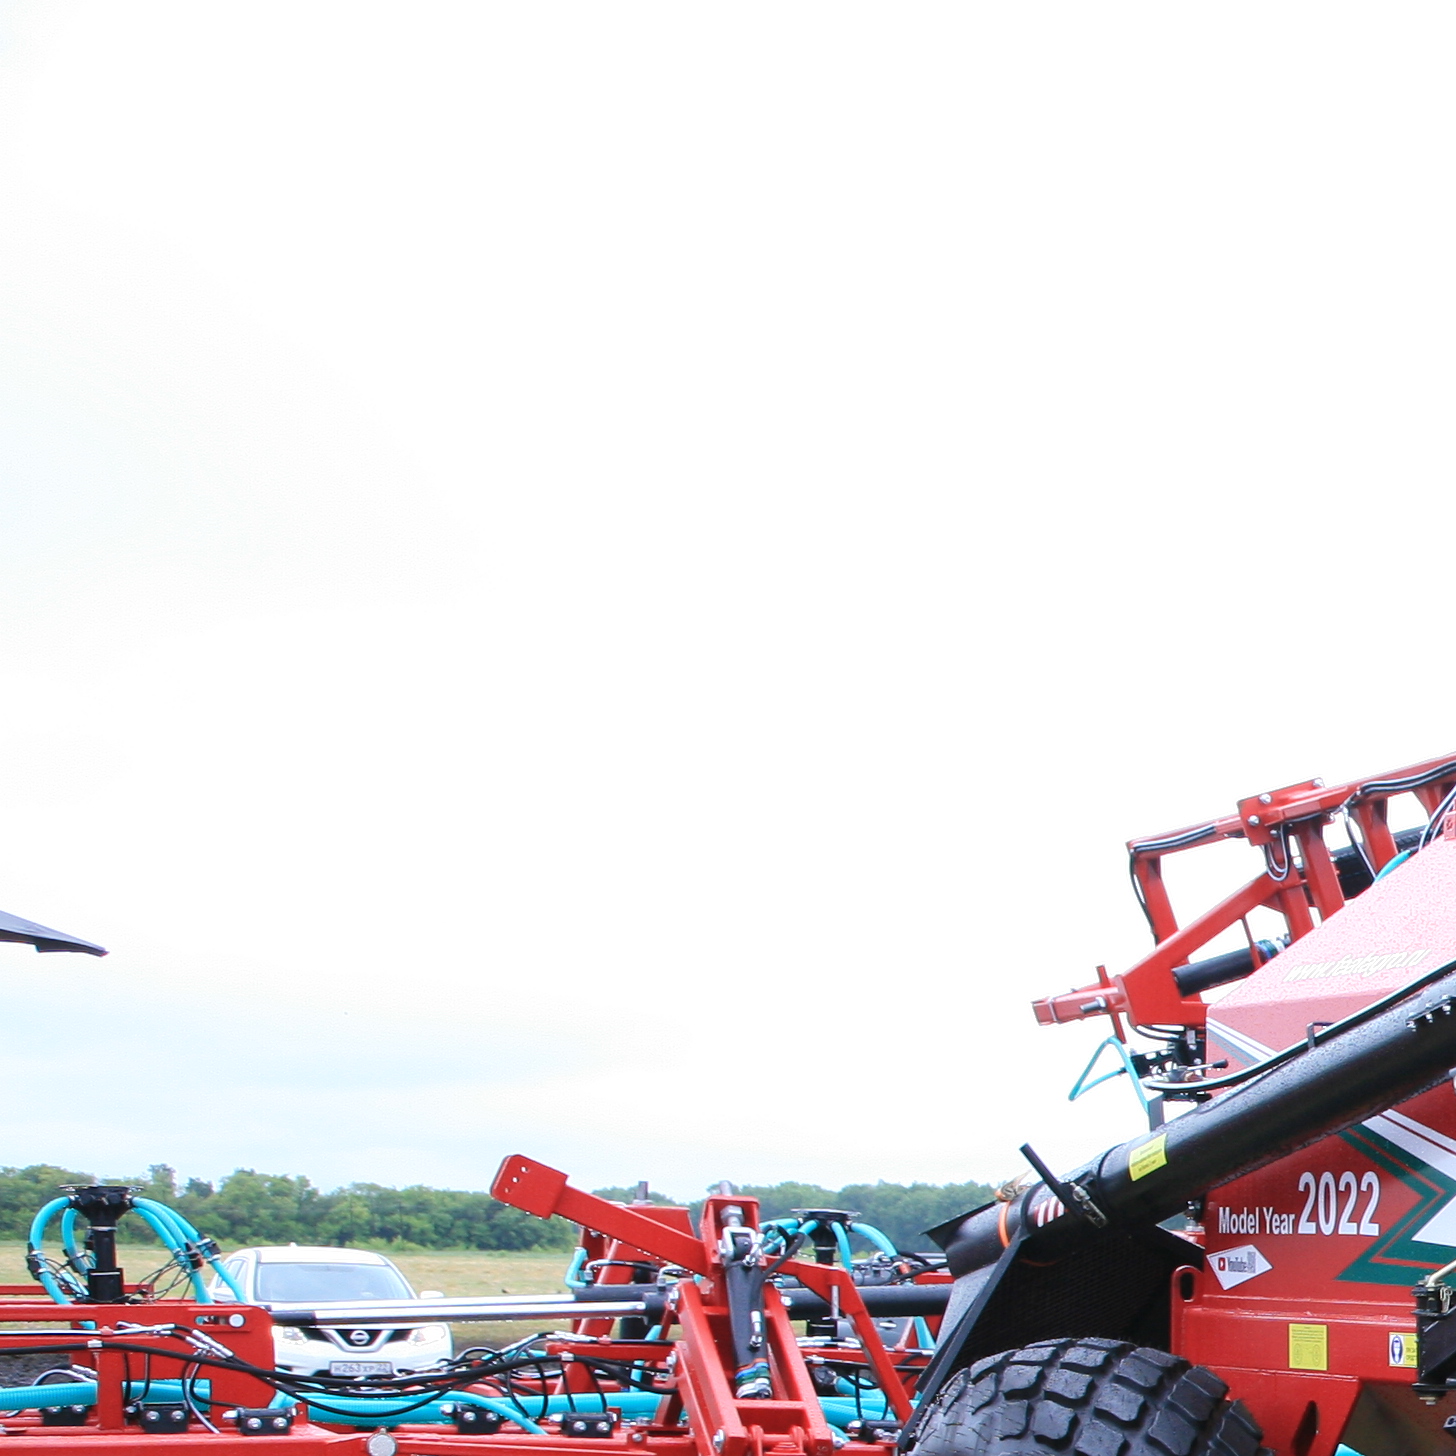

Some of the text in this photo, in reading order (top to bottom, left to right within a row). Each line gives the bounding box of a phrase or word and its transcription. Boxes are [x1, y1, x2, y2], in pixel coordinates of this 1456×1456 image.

[1218, 1170, 1380, 1237] Model Year 2022
